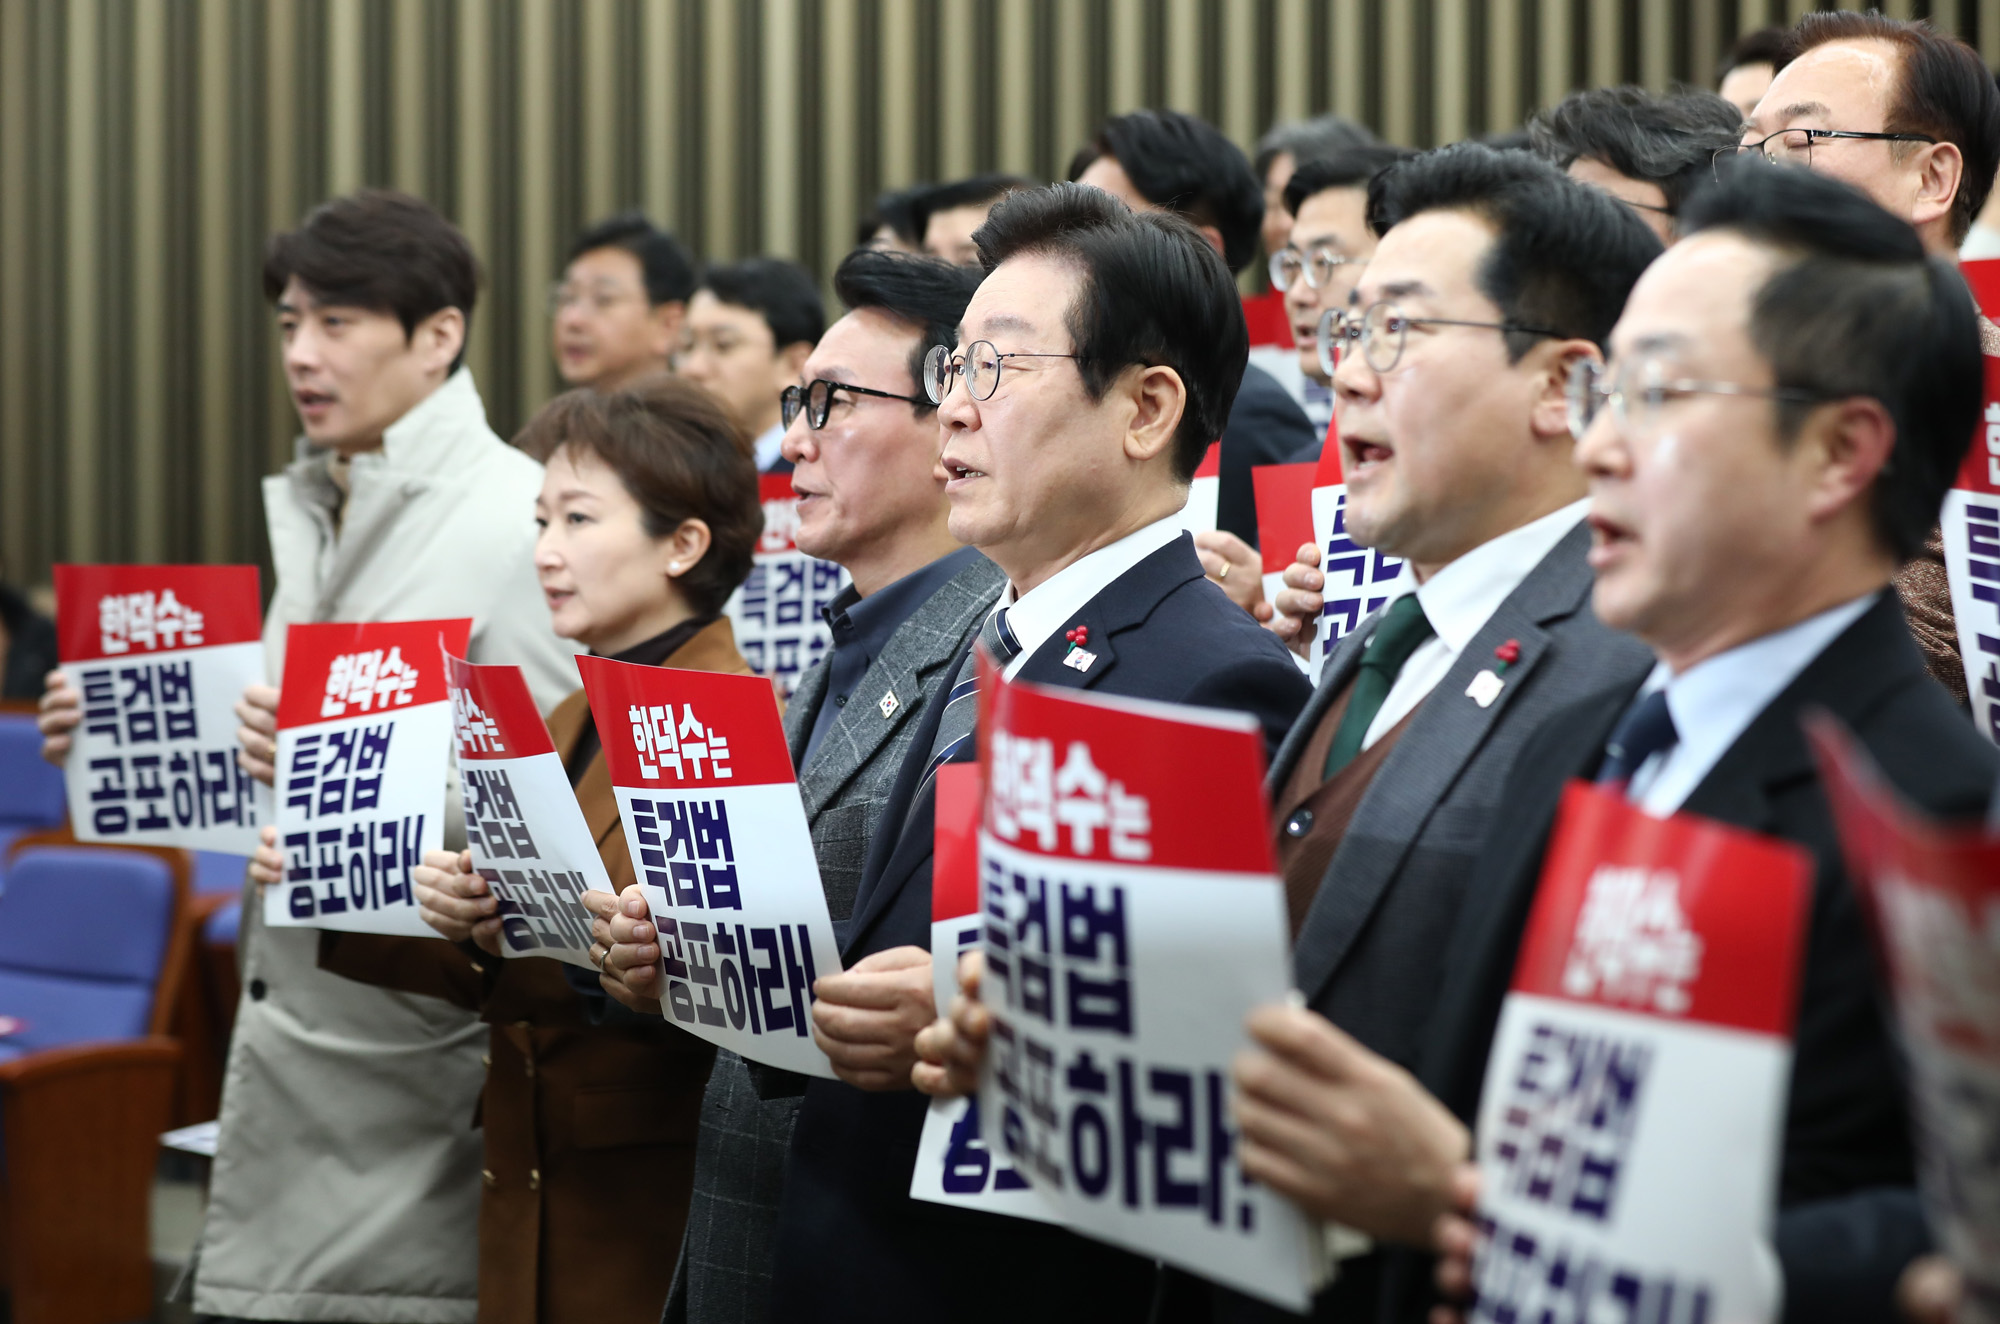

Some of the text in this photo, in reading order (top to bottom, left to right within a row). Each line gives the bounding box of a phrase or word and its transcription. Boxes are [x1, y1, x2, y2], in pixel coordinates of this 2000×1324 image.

[98, 588, 204, 655] 한덕수는
[81, 660, 199, 747] 특검법
[320, 646, 419, 717] 한덕수는
[287, 722, 394, 820] 특검법
[628, 702, 733, 780] 한덕수는
[630, 798, 742, 911] 특검법
